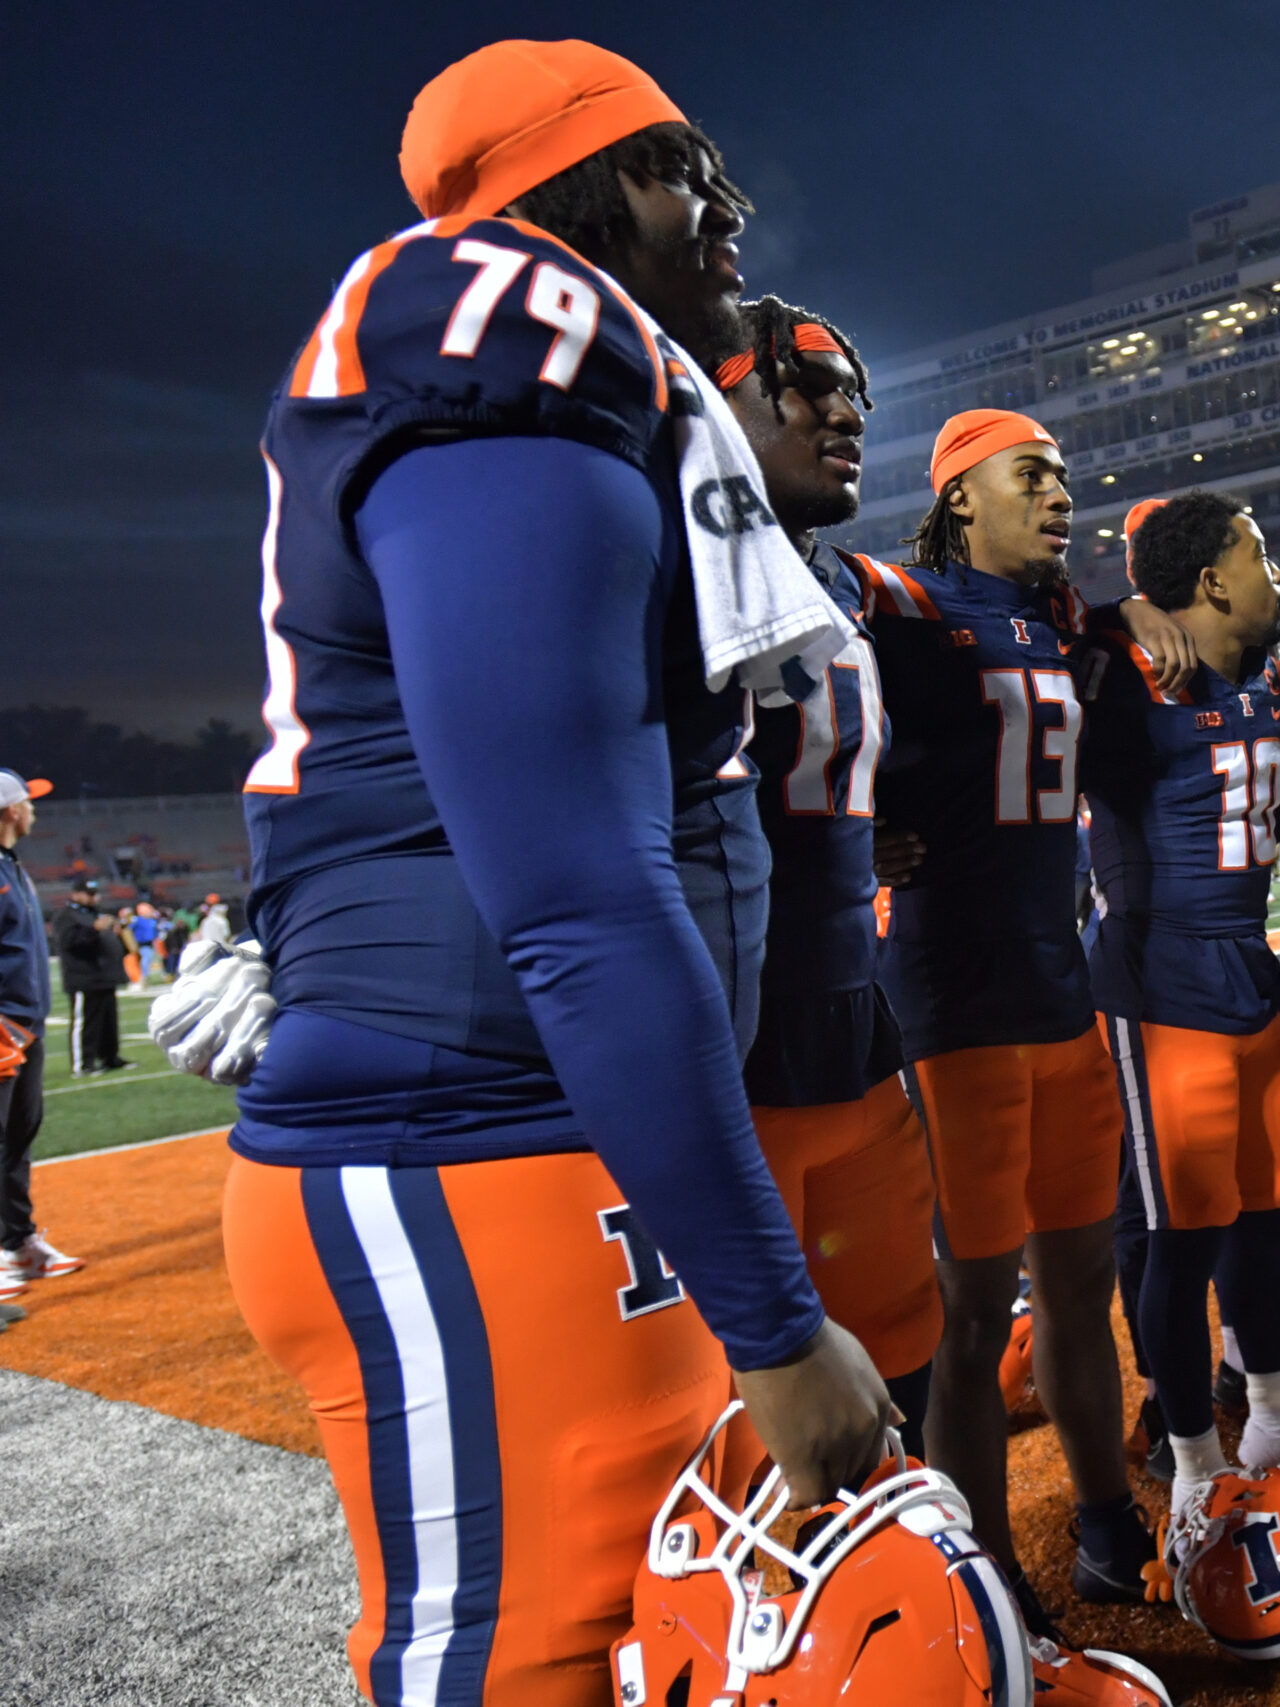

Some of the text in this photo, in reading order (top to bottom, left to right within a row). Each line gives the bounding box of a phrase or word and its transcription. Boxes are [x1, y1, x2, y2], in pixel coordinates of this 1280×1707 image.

[439, 239, 600, 393] 79
[941, 272, 1240, 370] WELCOME TO MEMORIAL STADIUM
[1186, 338, 1280, 378] NATIONAL
[979, 668, 1085, 825] 13
[596, 1203, 687, 1323] I
